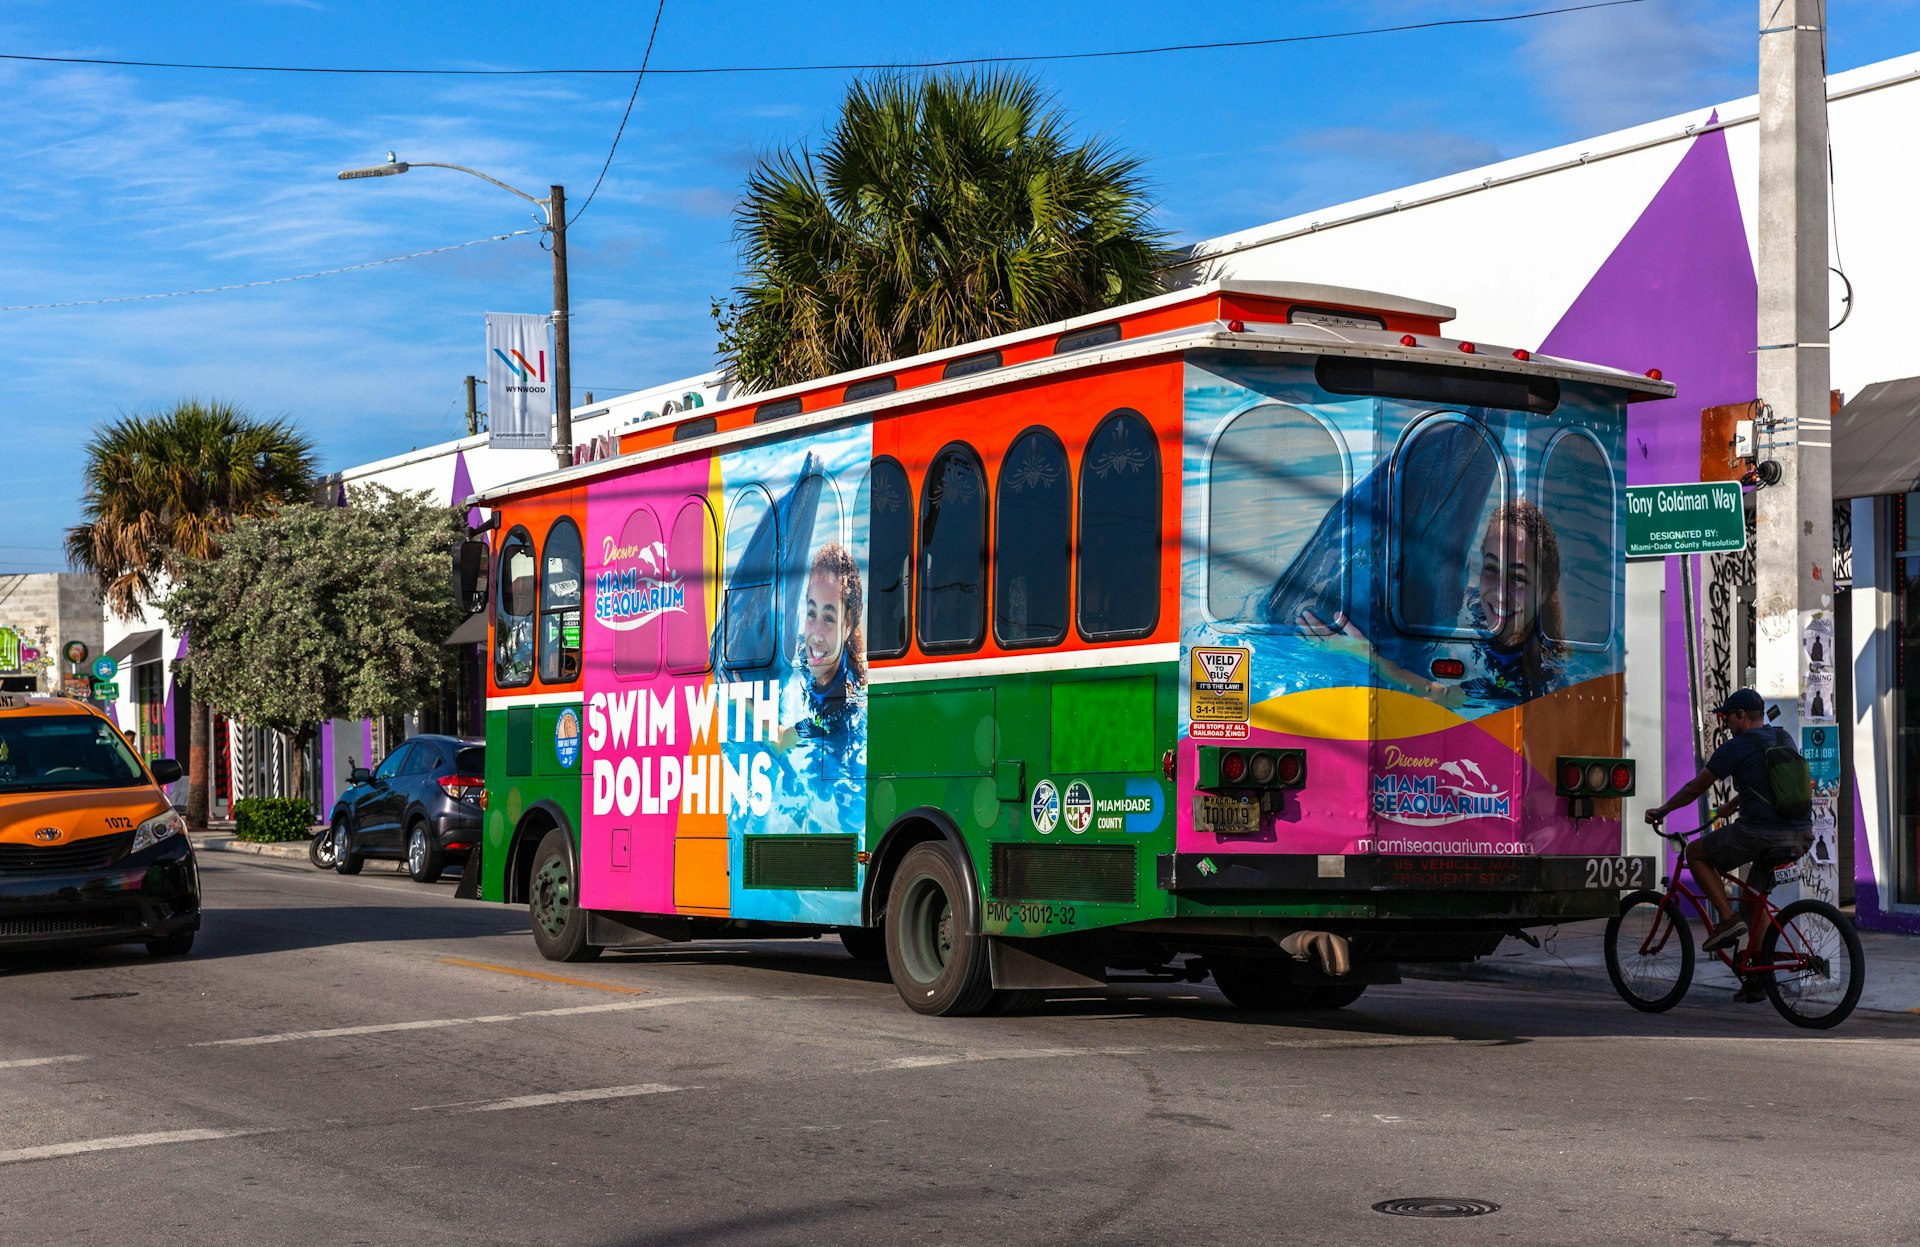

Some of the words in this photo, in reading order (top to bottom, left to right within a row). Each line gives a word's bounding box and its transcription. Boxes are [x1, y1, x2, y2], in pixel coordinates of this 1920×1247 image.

[1626, 492, 1653, 517] Tony
[1657, 490, 1708, 512] Goldman
[1711, 488, 1736, 513] Way
[1650, 530, 1702, 541] DESIGNATED
[1704, 529, 1719, 538] BY:
[602, 535, 639, 567] Discover
[1630, 542, 1672, 551] Miami-Dade
[1674, 540, 1700, 549] County
[1702, 539, 1740, 547] Resolution
[596, 567, 637, 596] MIAMI
[595, 583, 685, 619] SEAQUARIUM
[1206, 655, 1234, 665] YIELD
[1210, 671, 1229, 679] BUS
[0, 696, 13, 707] NT
[588, 685, 676, 751] SWIM
[684, 680, 780, 746] WITH
[1196, 705, 1216, 714] 3-1-1
[1385, 745, 1440, 770] Discover
[1804, 749, 1814, 758] GET
[593, 751, 772, 816] DOLPHINS
[1373, 774, 1436, 794] MIAMI
[1373, 793, 1510, 816] SEAQUARIUM
[105, 817, 133, 828] 1072
[1097, 817, 1123, 829] COUNTY
[1358, 837, 1535, 855] miamiseaquarium.com
[1420, 858, 1482, 870] VEHICLE
[1392, 873, 1473, 884] FREQUENT
[1585, 858, 1643, 888] 2032
[1775, 870, 1791, 880] RENT
[987, 904, 1076, 925] PMC-31012-32
